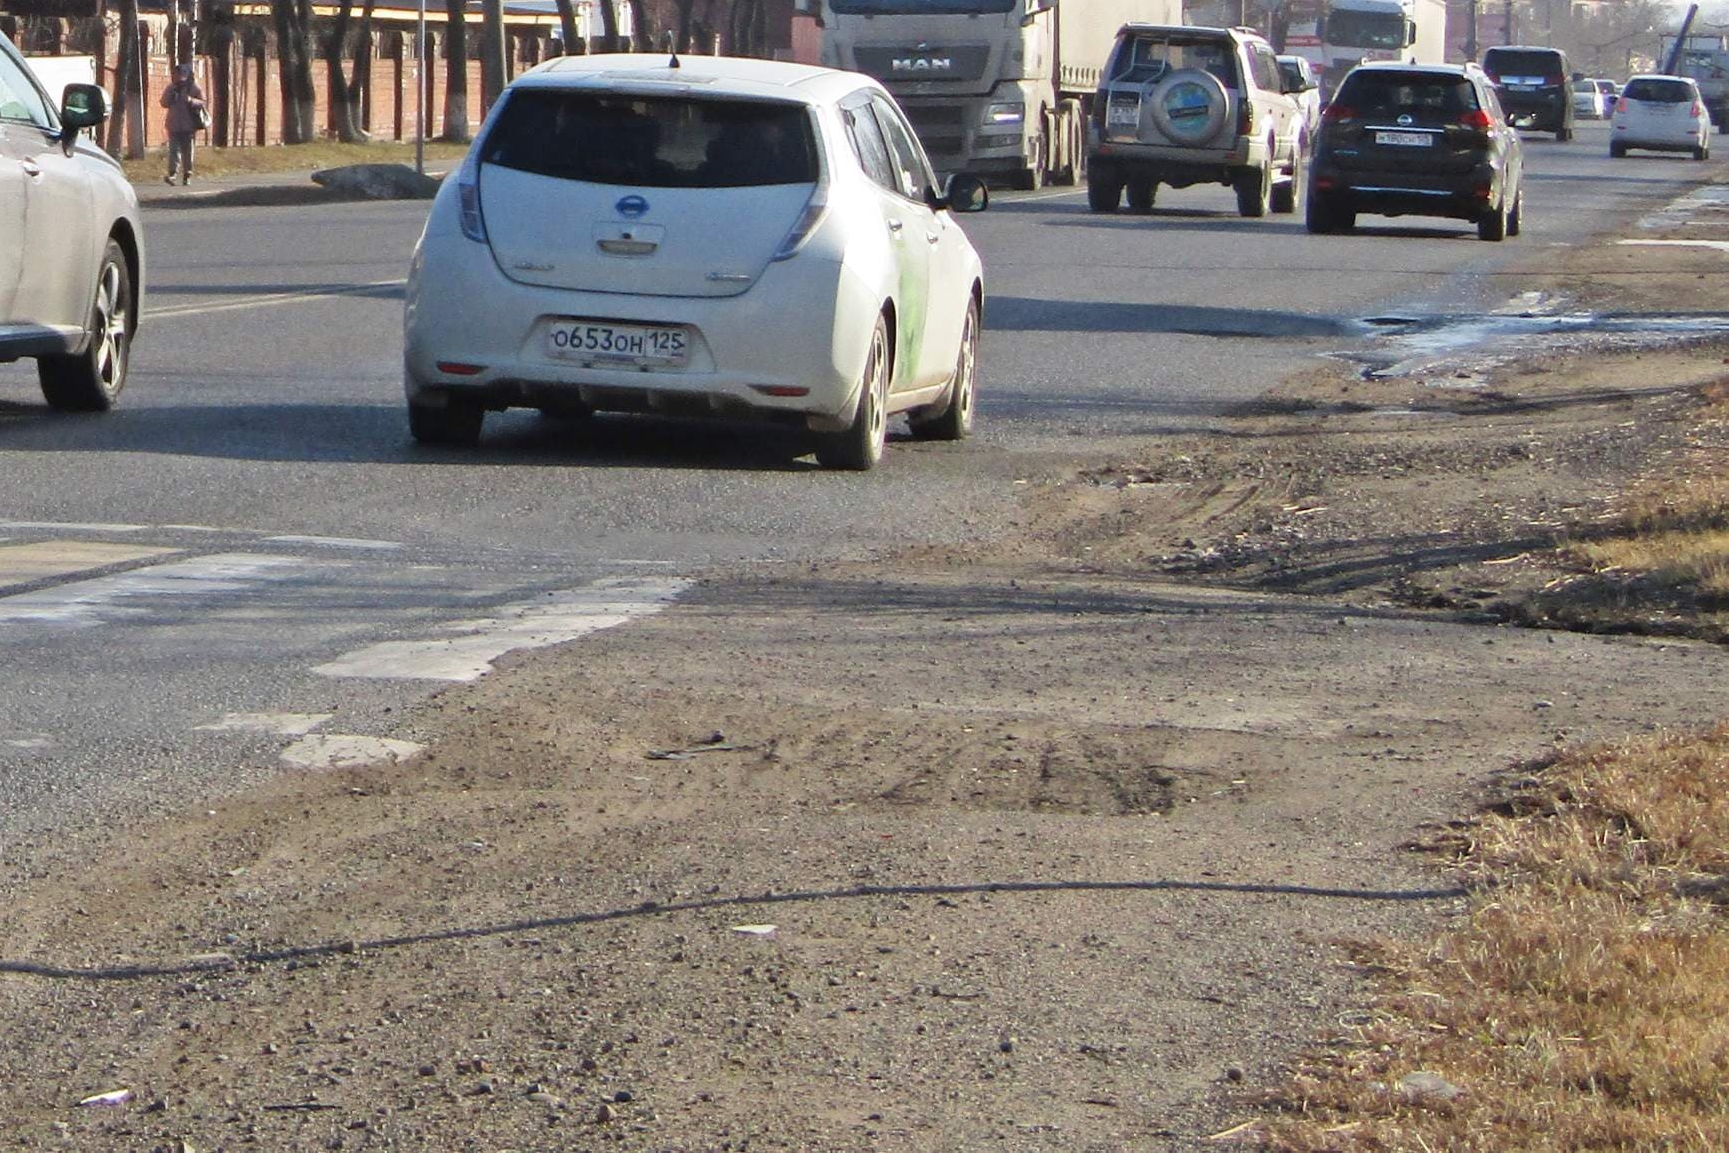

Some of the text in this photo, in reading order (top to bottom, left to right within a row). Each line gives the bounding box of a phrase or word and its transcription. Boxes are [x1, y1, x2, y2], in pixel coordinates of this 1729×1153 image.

[892, 58, 951, 71] MAN
[554, 327, 685, 353] О653ОН 125
